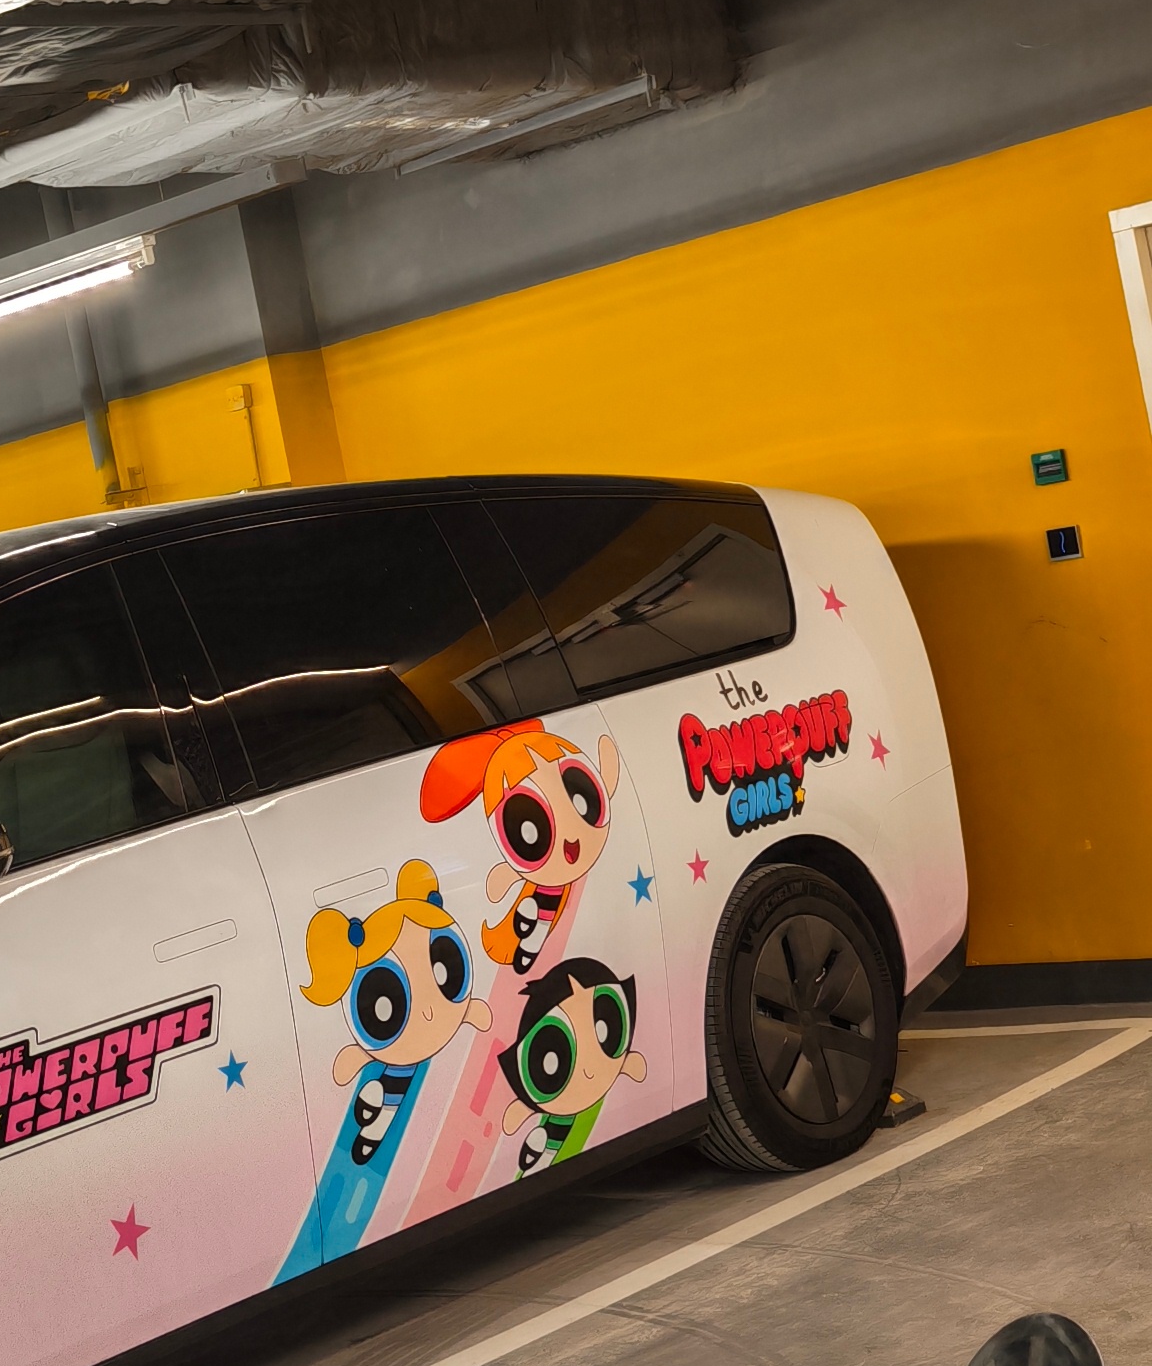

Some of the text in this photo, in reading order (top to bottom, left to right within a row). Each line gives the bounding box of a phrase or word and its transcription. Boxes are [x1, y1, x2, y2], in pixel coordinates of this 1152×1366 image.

[716, 670, 768, 711] the
[728, 772, 794, 831] GIRLS
[4, 1057, 152, 1143] GIRLS
